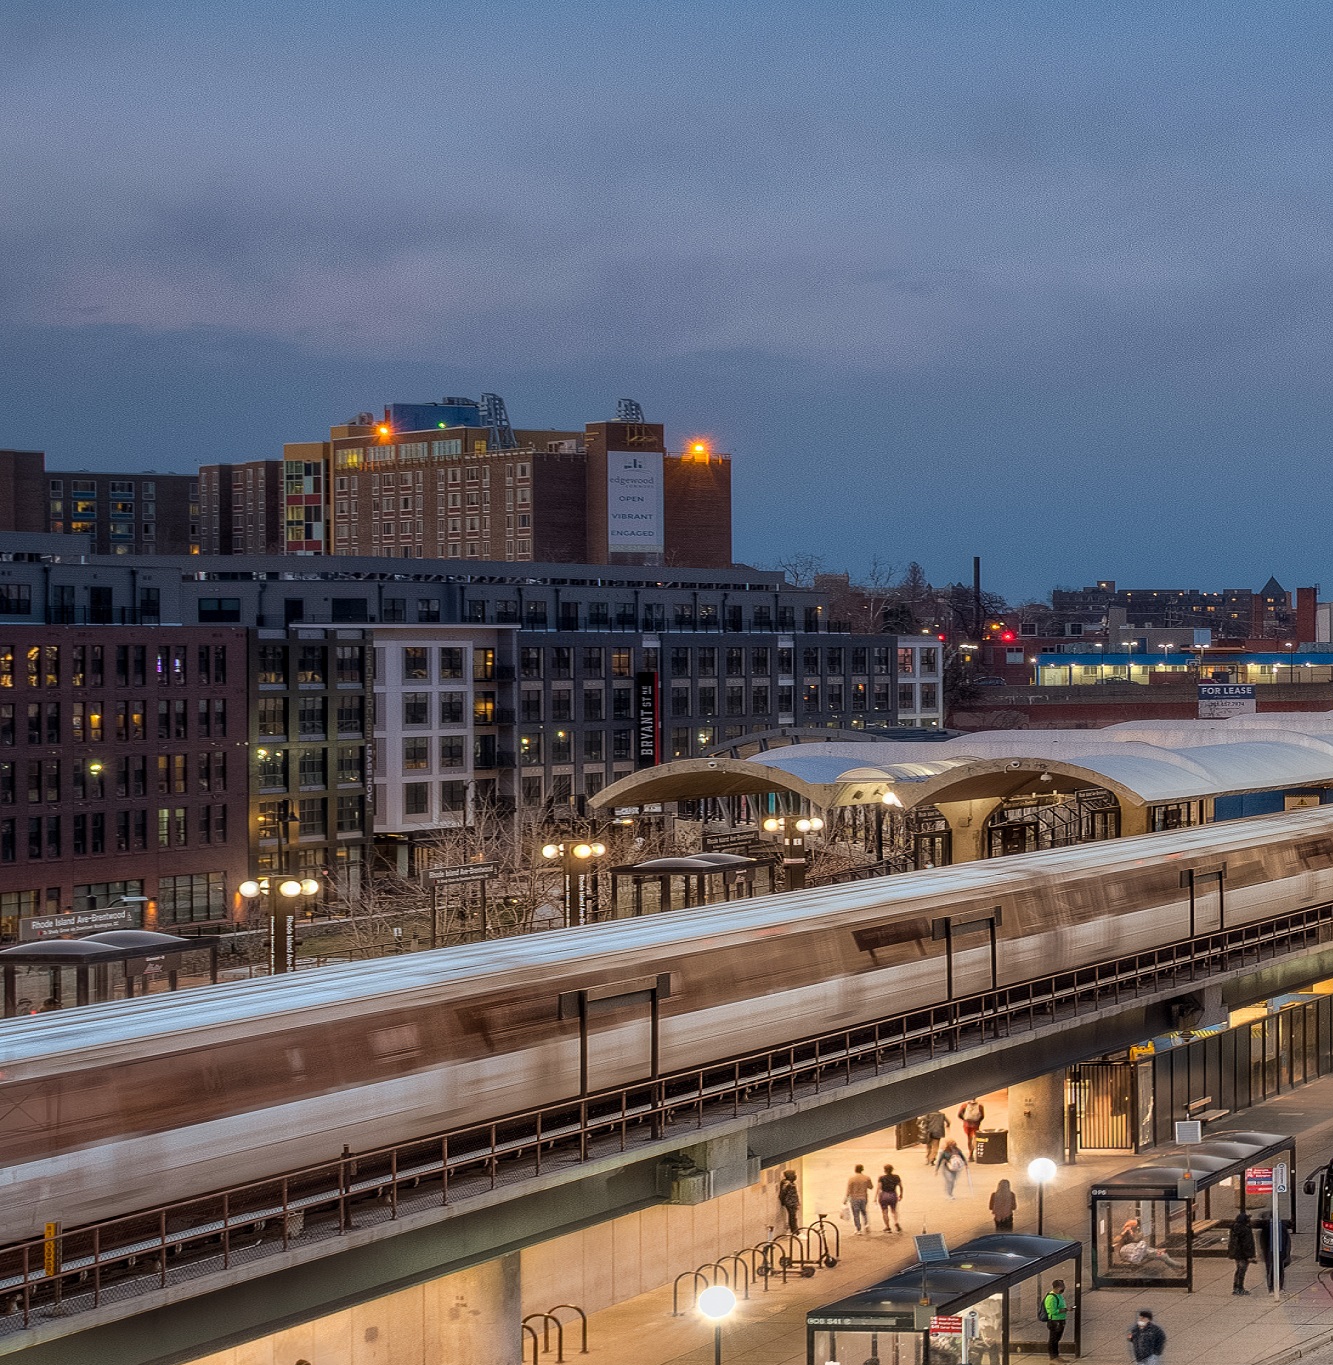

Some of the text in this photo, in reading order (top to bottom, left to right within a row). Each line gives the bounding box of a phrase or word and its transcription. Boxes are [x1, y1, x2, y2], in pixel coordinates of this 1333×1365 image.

[610, 476, 654, 485] edgewood
[1201, 687, 1221, 695] FOR
[642, 697, 652, 707] ST
[640, 709, 653, 756] BRYANT
[32, 920, 54, 930] Rhode
[55, 917, 75, 927] Island
